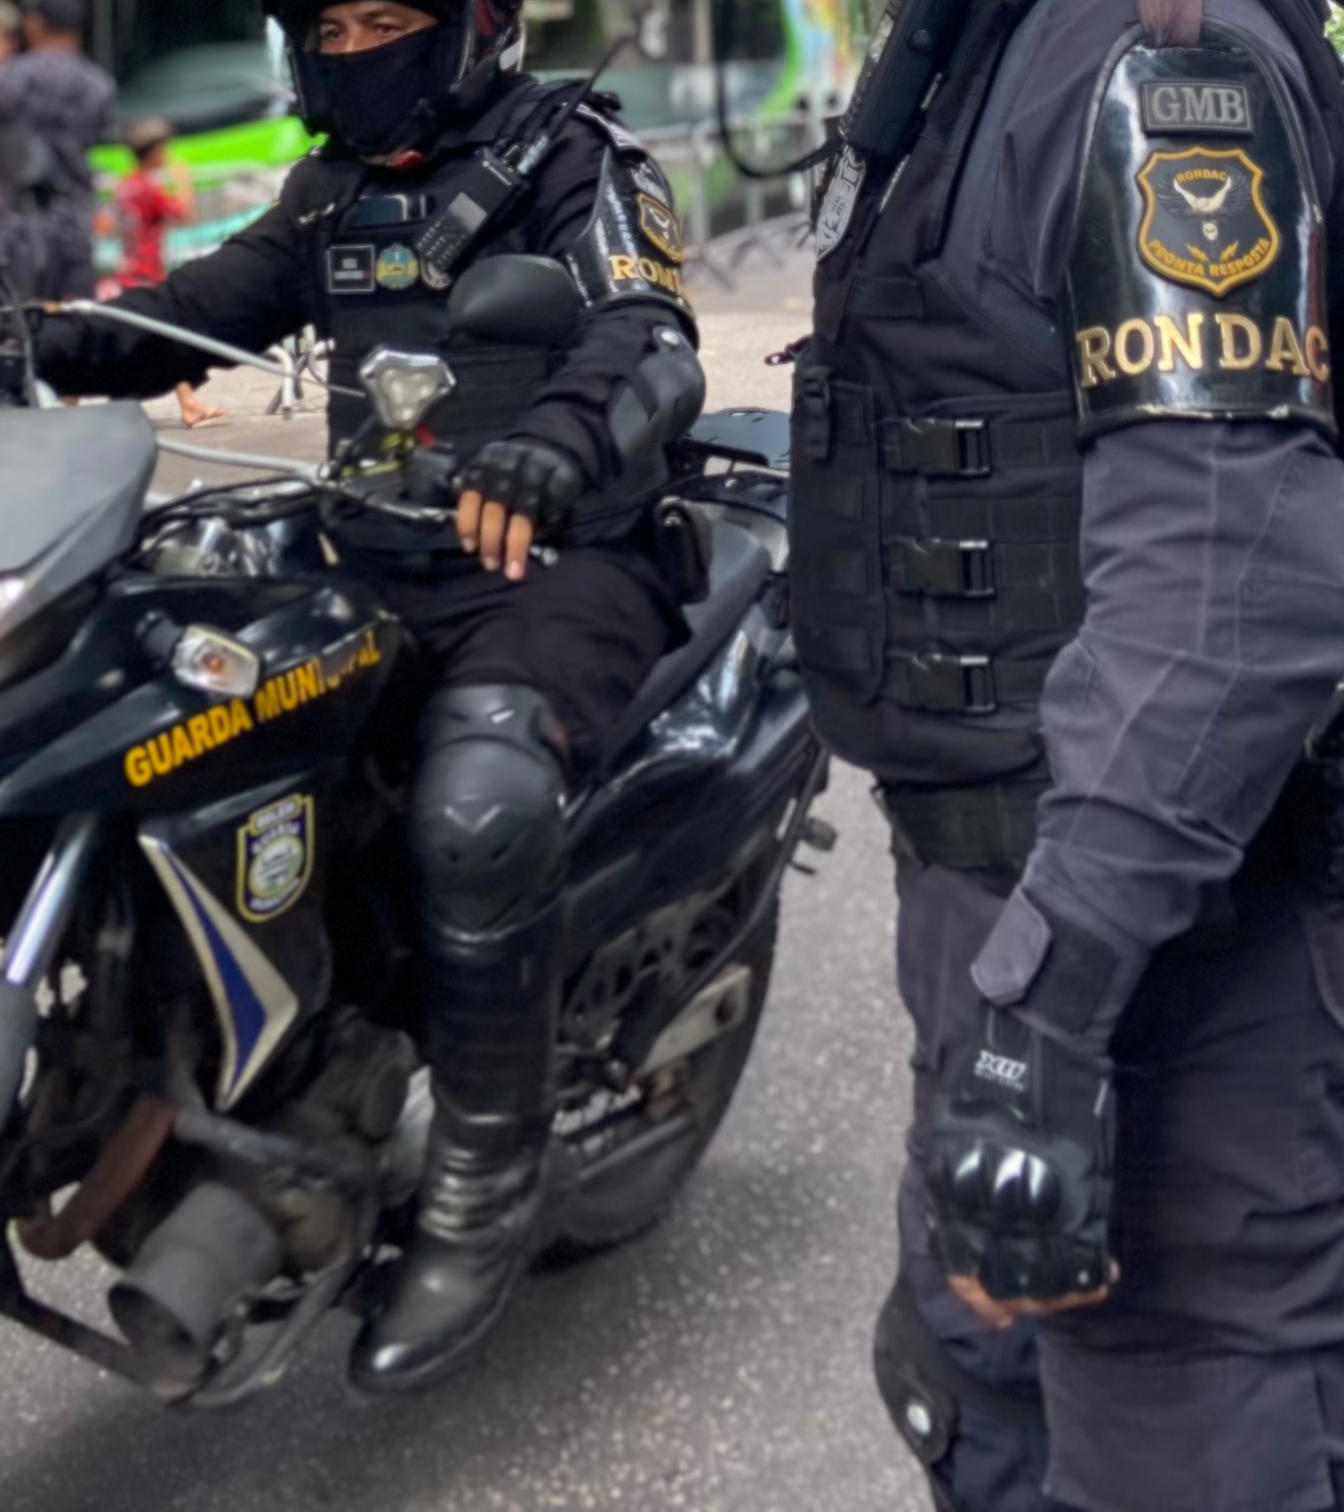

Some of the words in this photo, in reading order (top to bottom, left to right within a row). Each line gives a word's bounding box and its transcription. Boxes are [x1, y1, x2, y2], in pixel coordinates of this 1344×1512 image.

[1152, 87, 1245, 123] GMB
[1175, 168, 1229, 183] RONDAC
[1148, 239, 1205, 277] PRONTA
[1209, 238, 1272, 277] RESPOSTA
[1076, 311, 1330, 388] RONDAC
[123, 696, 254, 787] GUARDA
